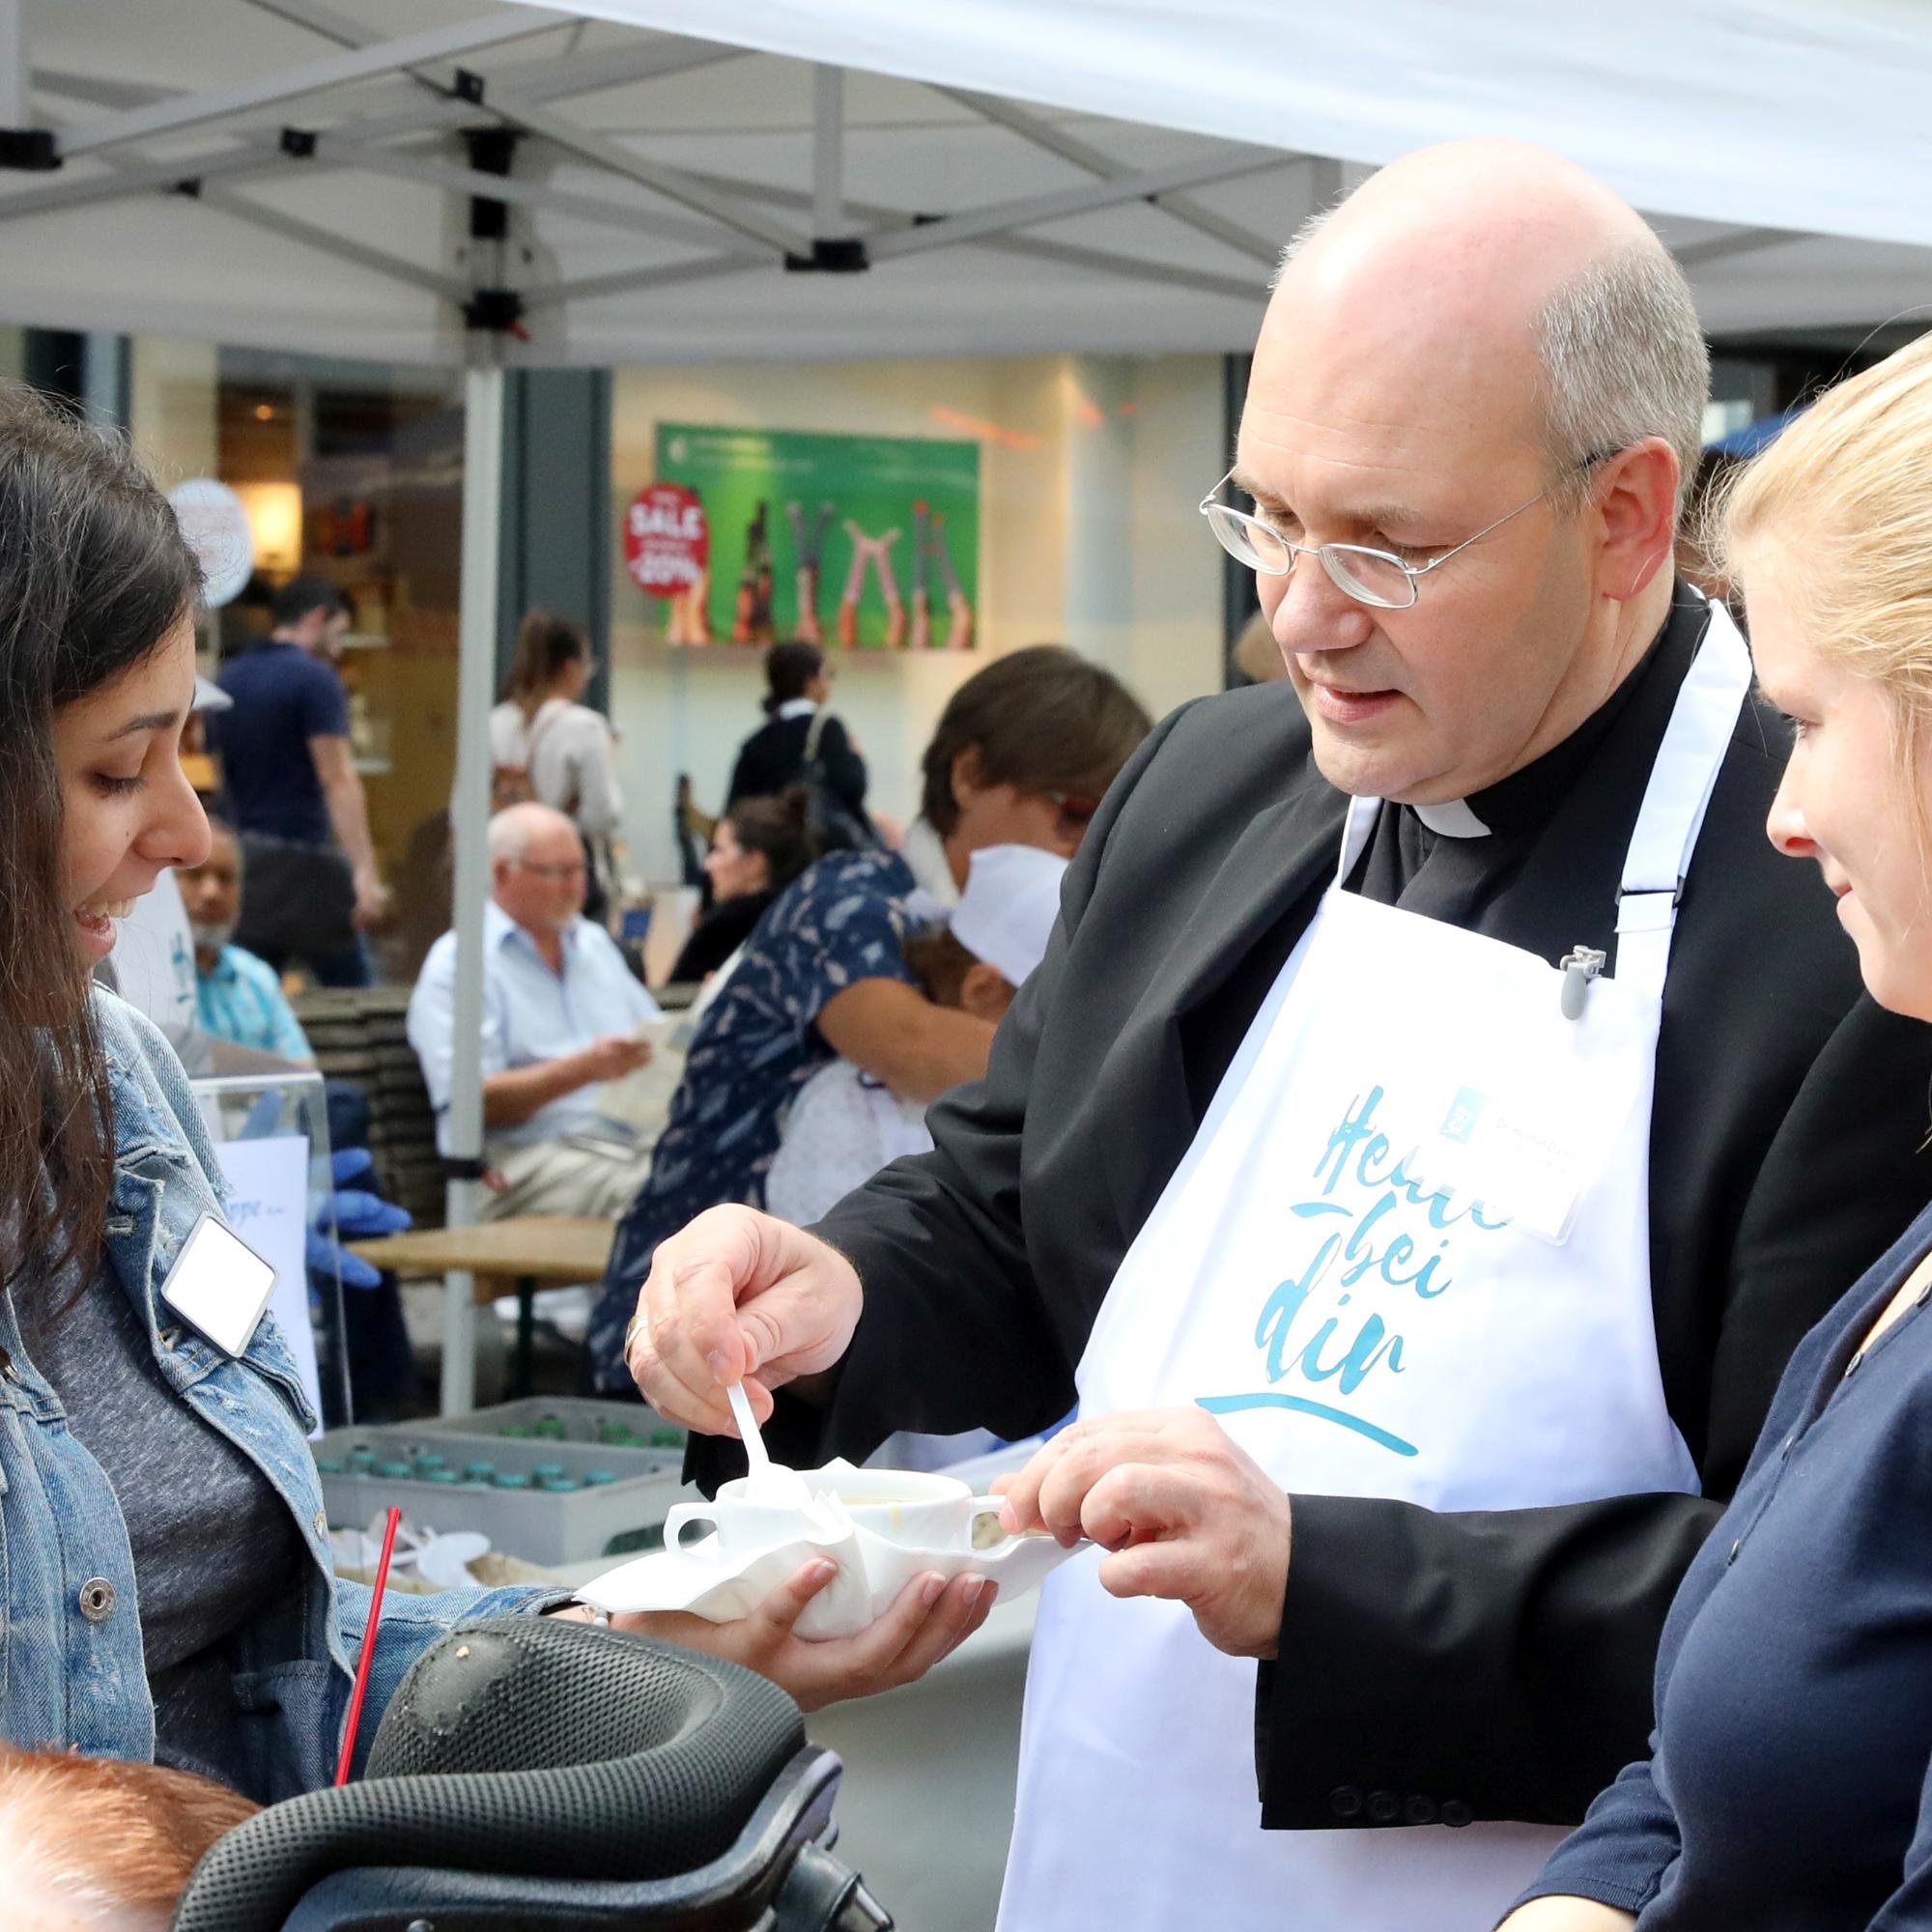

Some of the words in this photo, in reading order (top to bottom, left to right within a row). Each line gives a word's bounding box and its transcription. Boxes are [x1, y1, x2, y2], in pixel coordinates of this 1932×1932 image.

[631, 502, 703, 539] SALE
[1341, 1191, 1453, 1299] bei
[1255, 1233, 1407, 1396] dir
